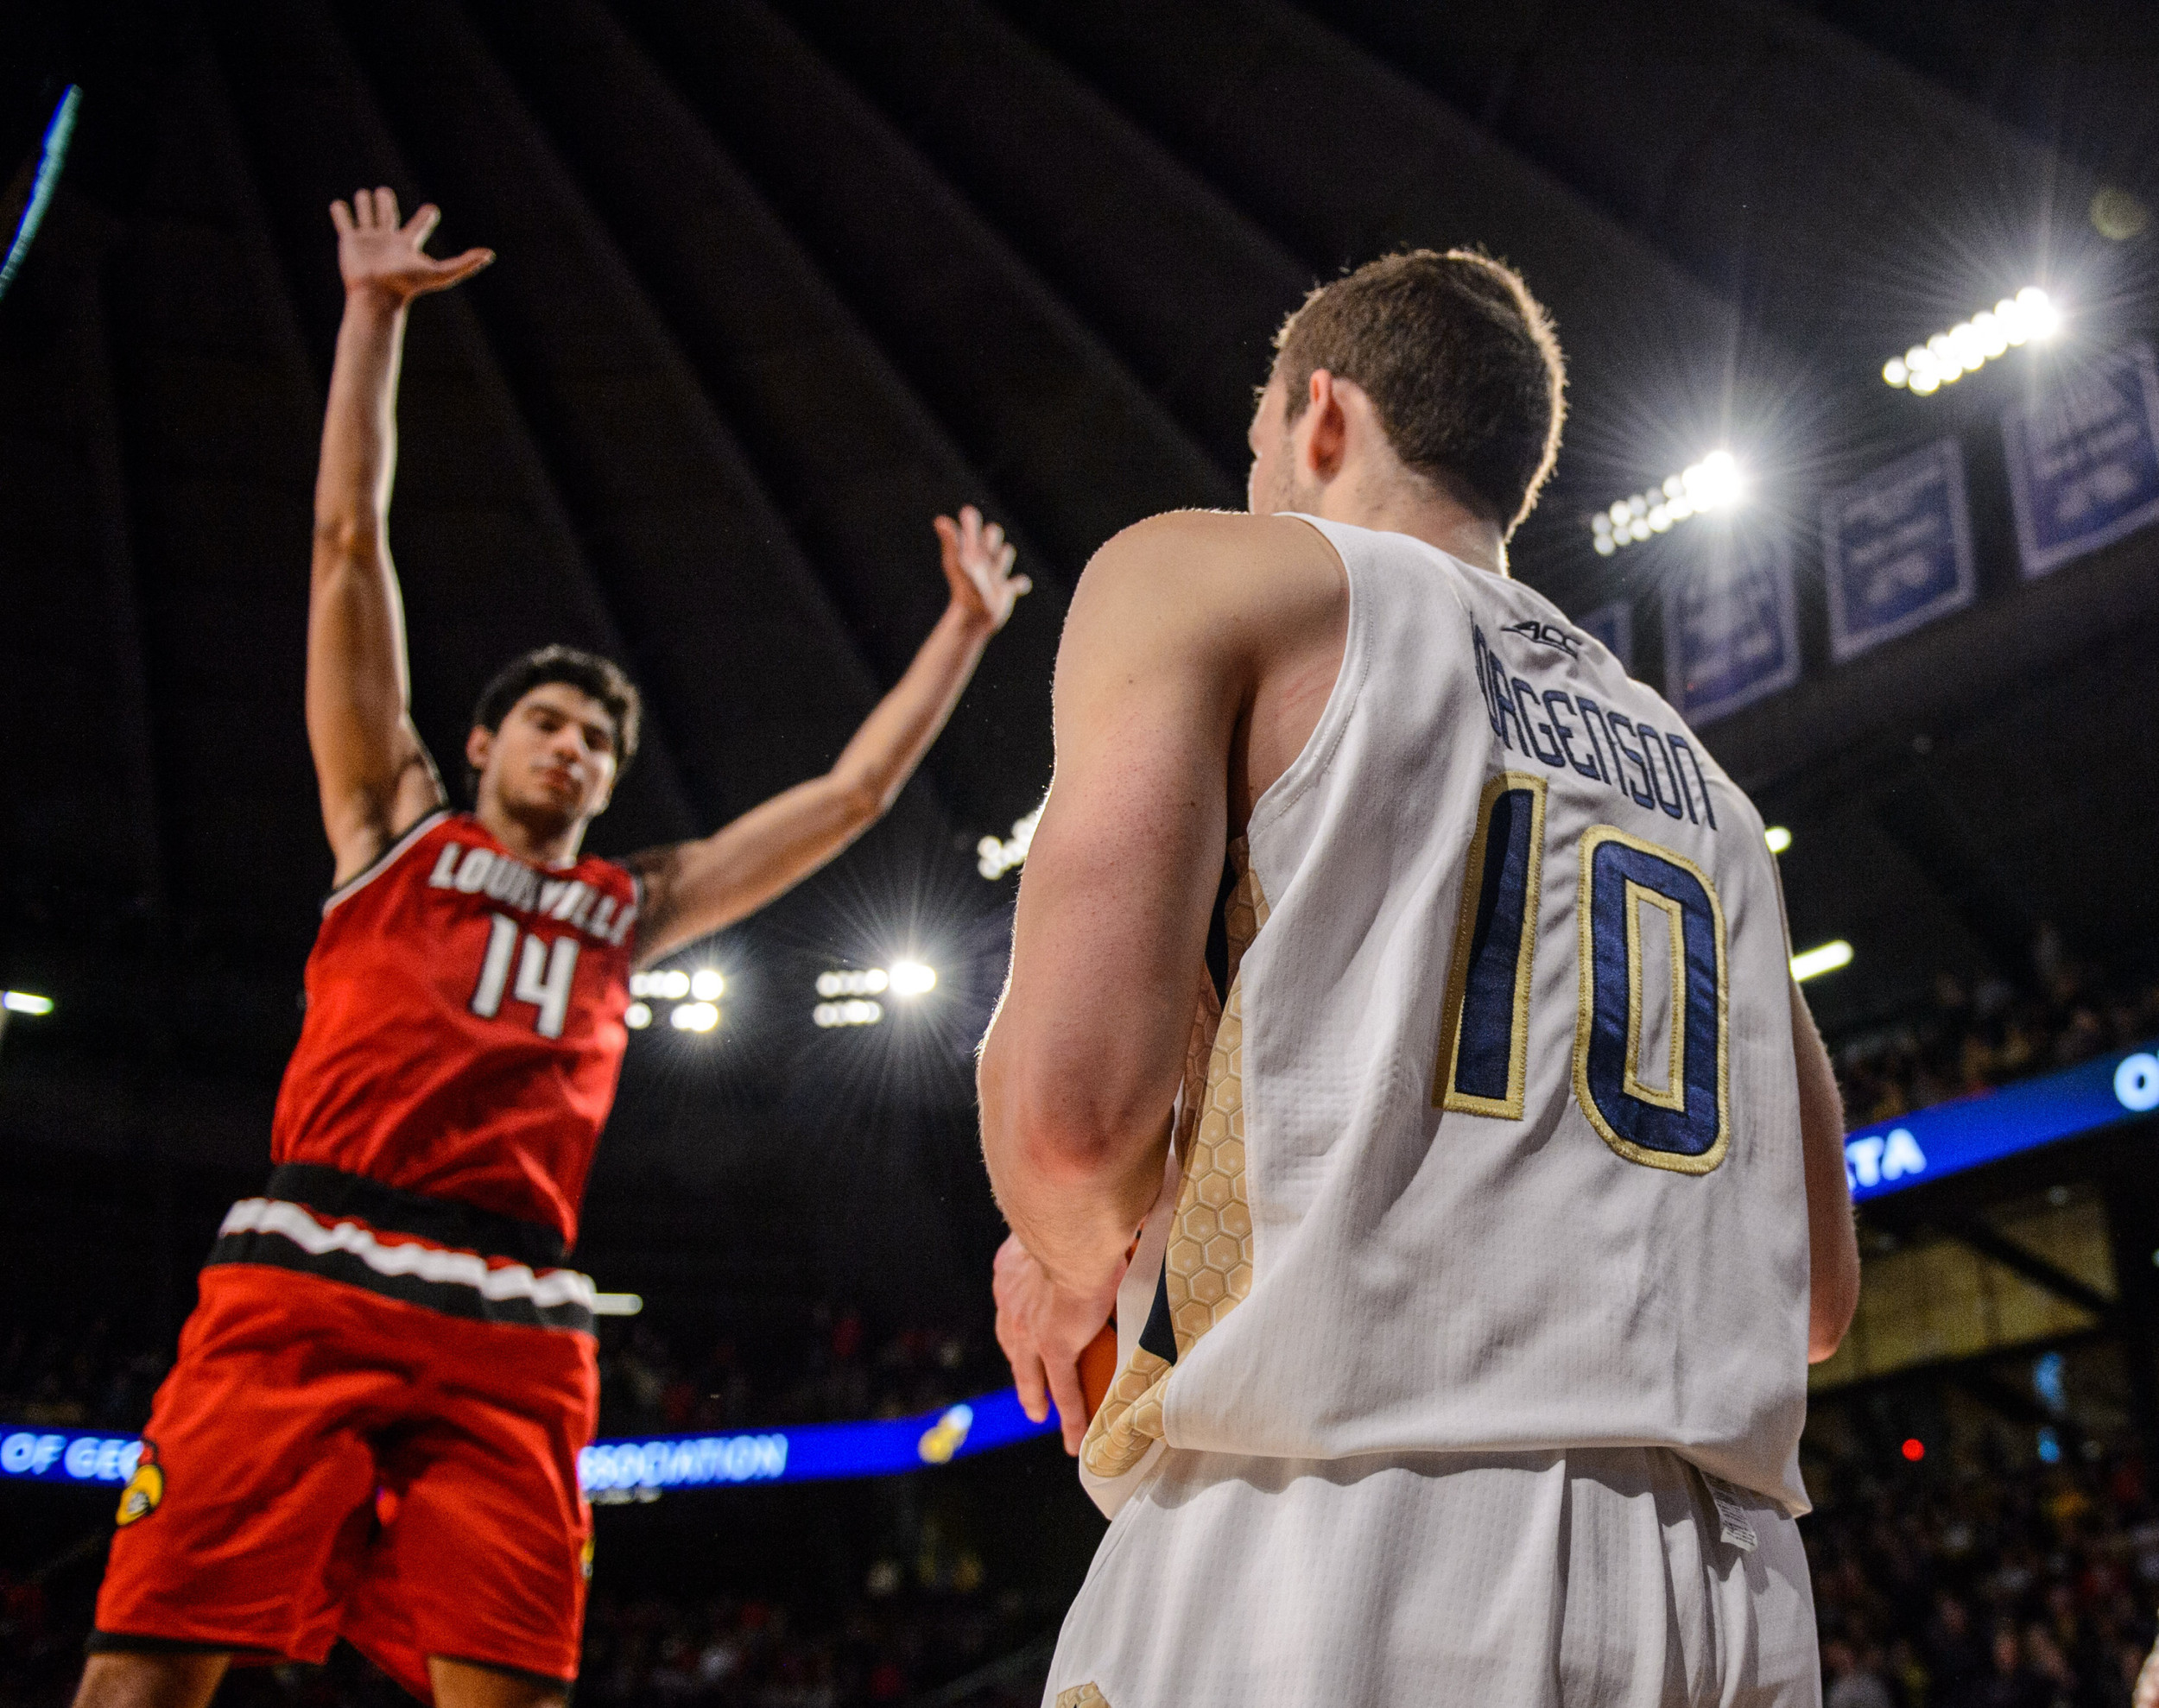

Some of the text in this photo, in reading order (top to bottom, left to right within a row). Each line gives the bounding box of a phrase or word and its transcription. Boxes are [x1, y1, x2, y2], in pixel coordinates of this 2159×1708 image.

[1501, 620, 1582, 660] ACC
[1468, 608, 1718, 832] ORGENSON
[472, 912, 580, 1040] 14
[1432, 771, 1730, 1176] 10
[1845, 1128, 1927, 1188] TA
[0, 1432, 66, 1475] OF
